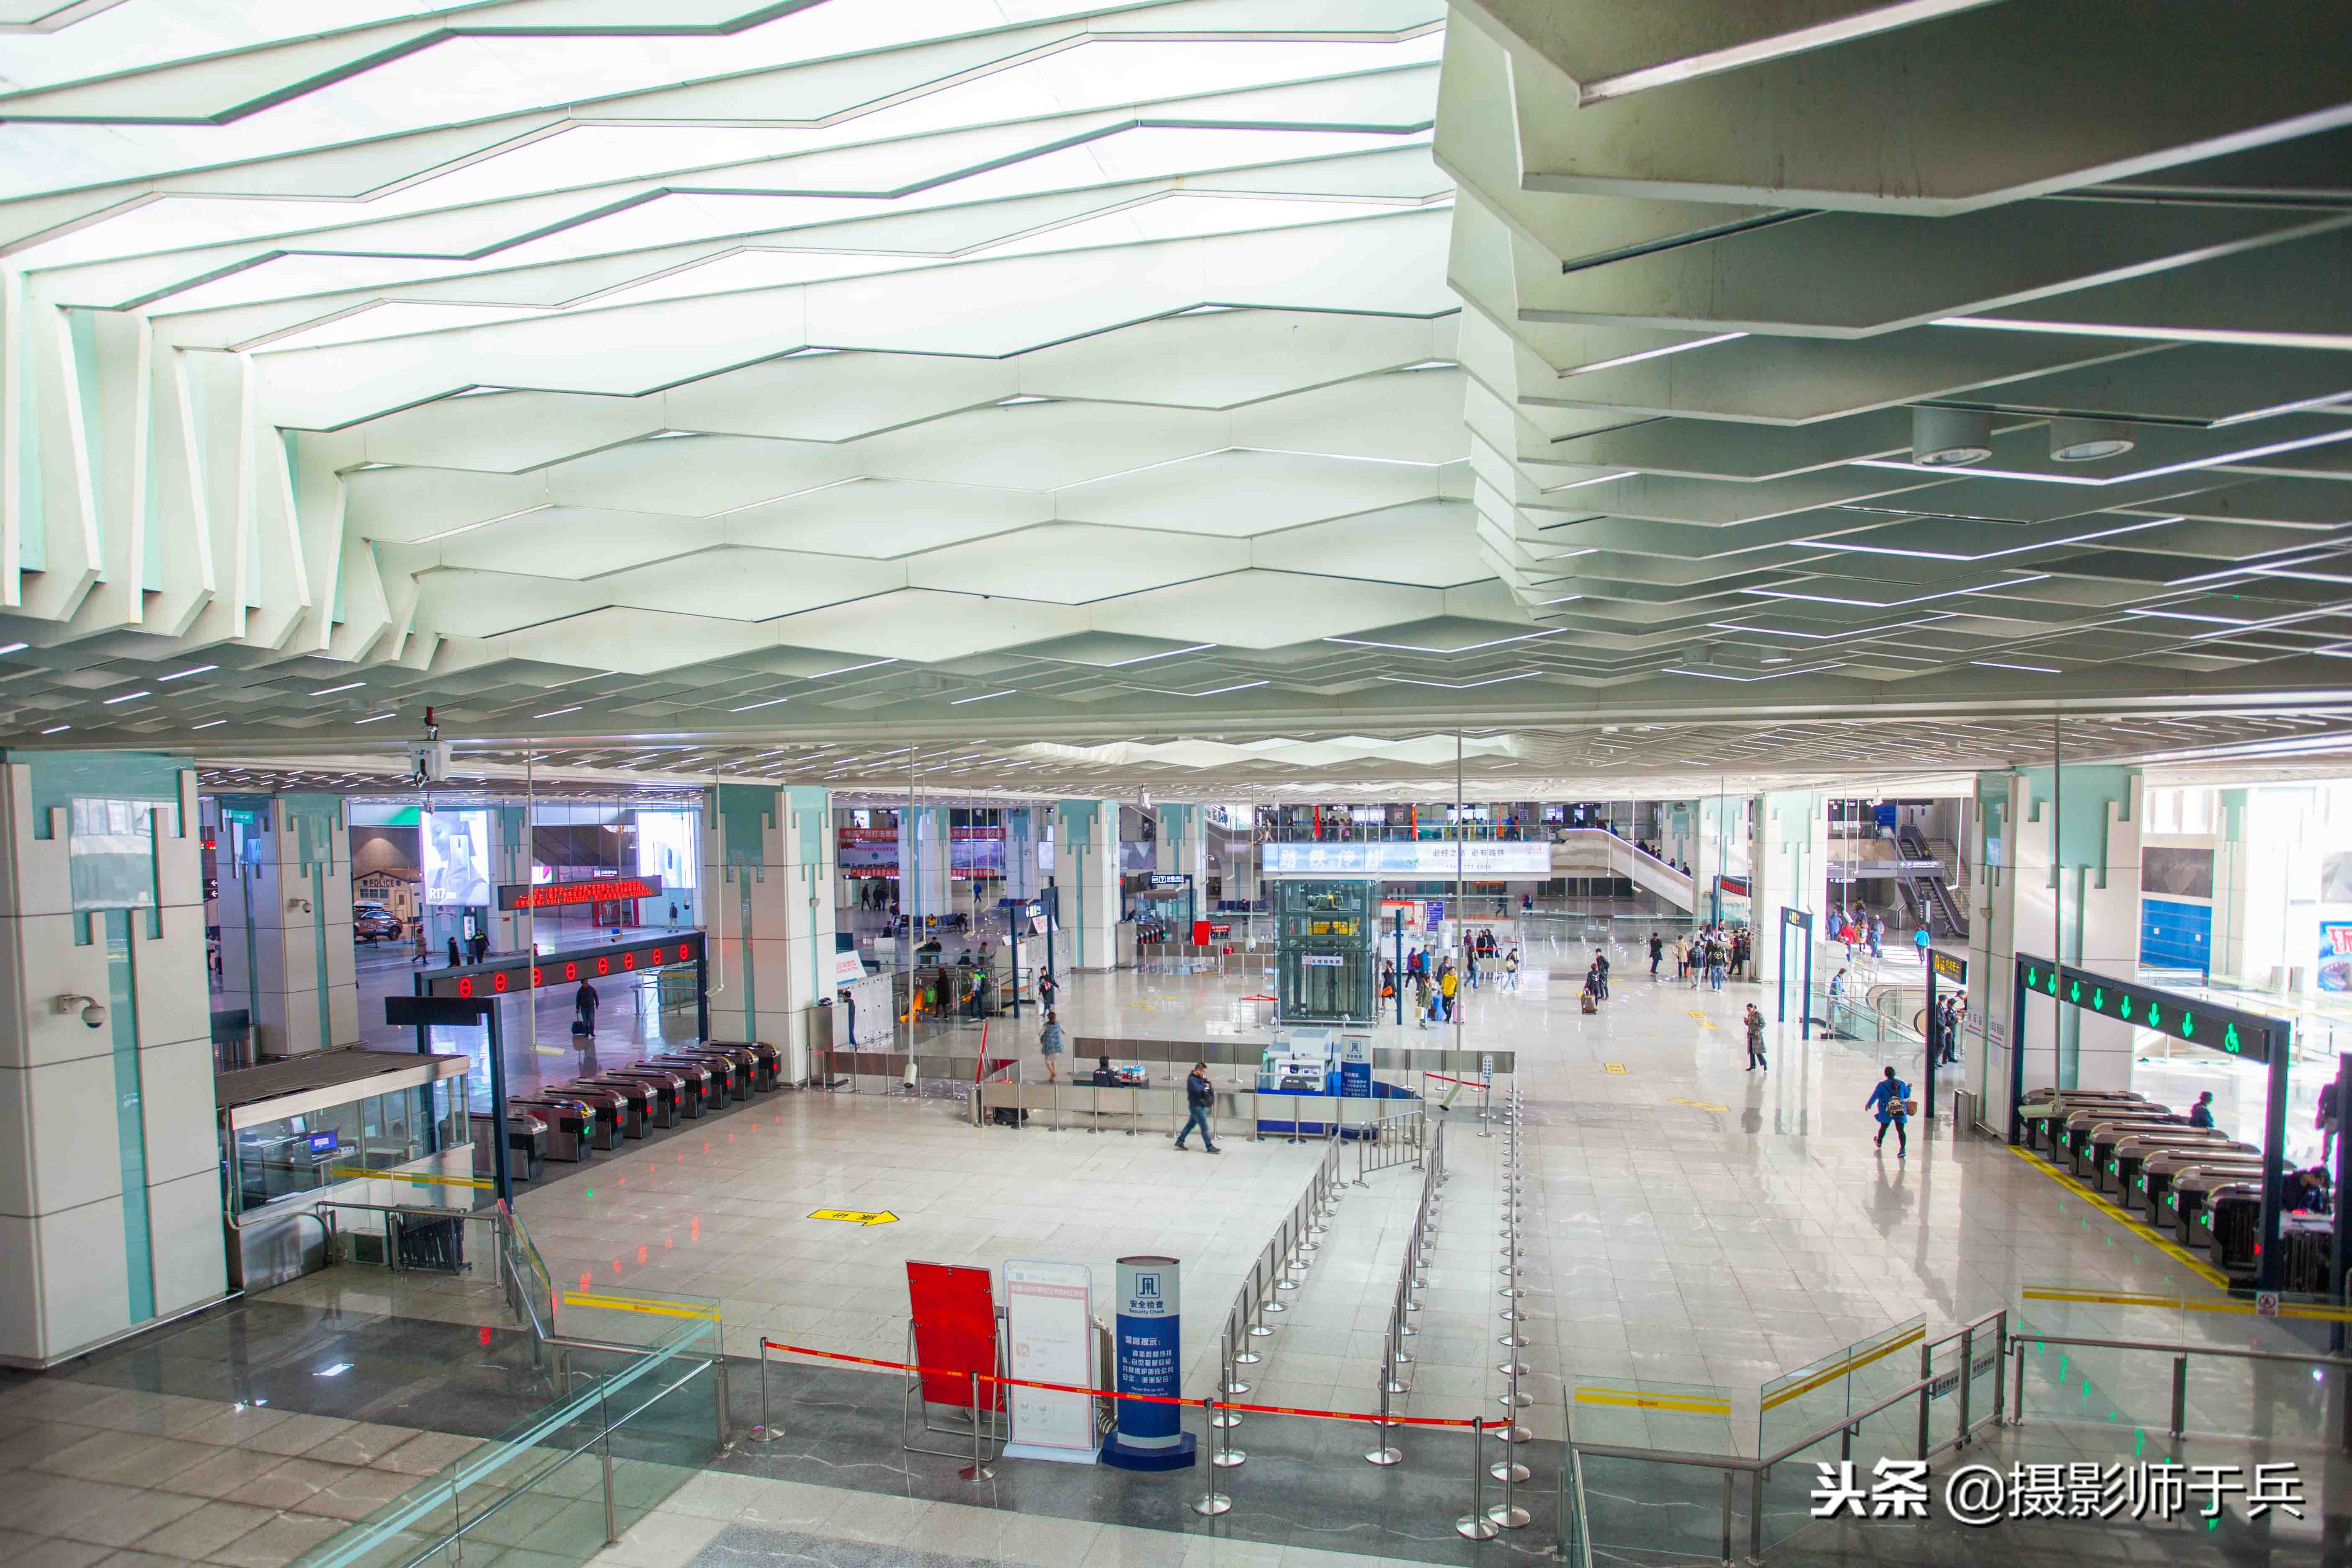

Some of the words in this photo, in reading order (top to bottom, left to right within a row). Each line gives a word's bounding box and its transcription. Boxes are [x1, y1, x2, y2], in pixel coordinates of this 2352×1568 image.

[429, 887, 446, 899] R17
[1130, 1300, 1163, 1309] 安全检查
